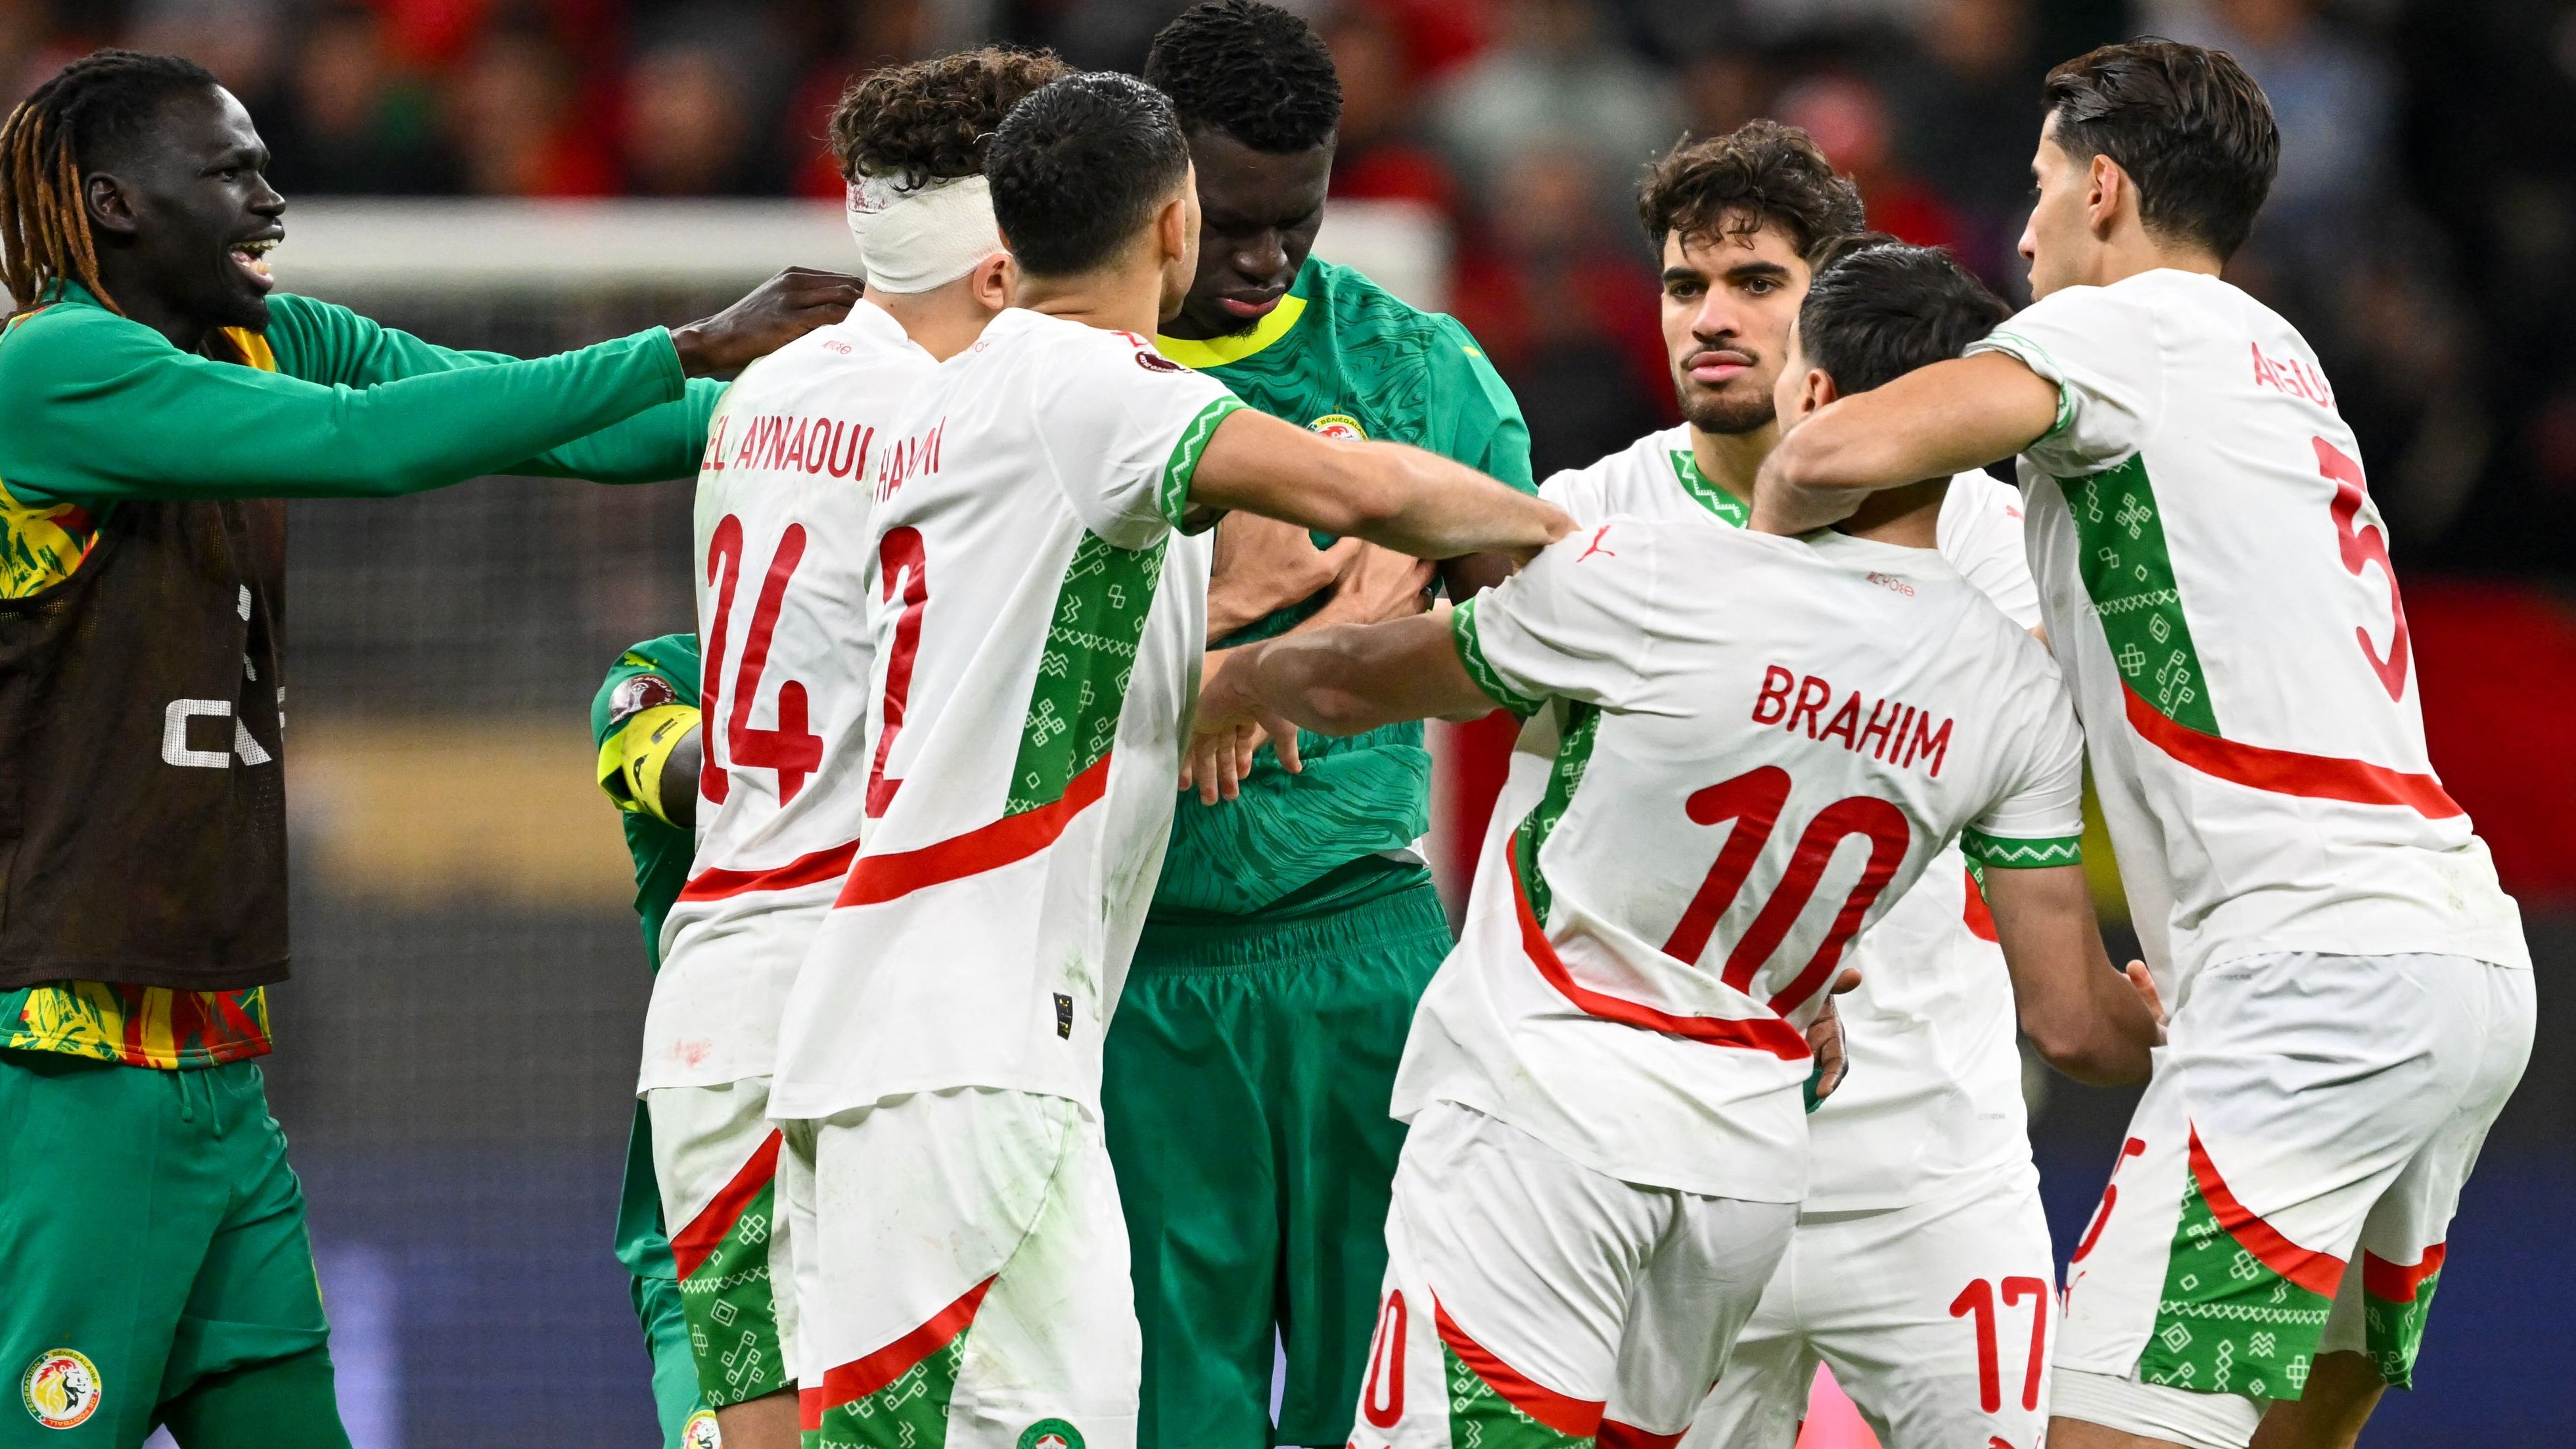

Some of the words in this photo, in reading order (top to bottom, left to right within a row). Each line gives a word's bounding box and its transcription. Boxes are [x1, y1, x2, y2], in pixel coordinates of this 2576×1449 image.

[1320, 417, 1366, 441] SÉNÉGALAIS
[2251, 341, 2337, 409] AGU
[702, 415, 728, 471] EL
[734, 415, 875, 482] AYNAOUI
[2312, 436, 2408, 702] 5
[864, 526, 928, 818] 2
[1752, 665, 1954, 778] BRAHIM
[1661, 766, 1910, 1018] 10
[2071, 1137, 2147, 1264] 5
[1364, 1289, 1408, 1428] 0
[1949, 1276, 2048, 1414] 17
